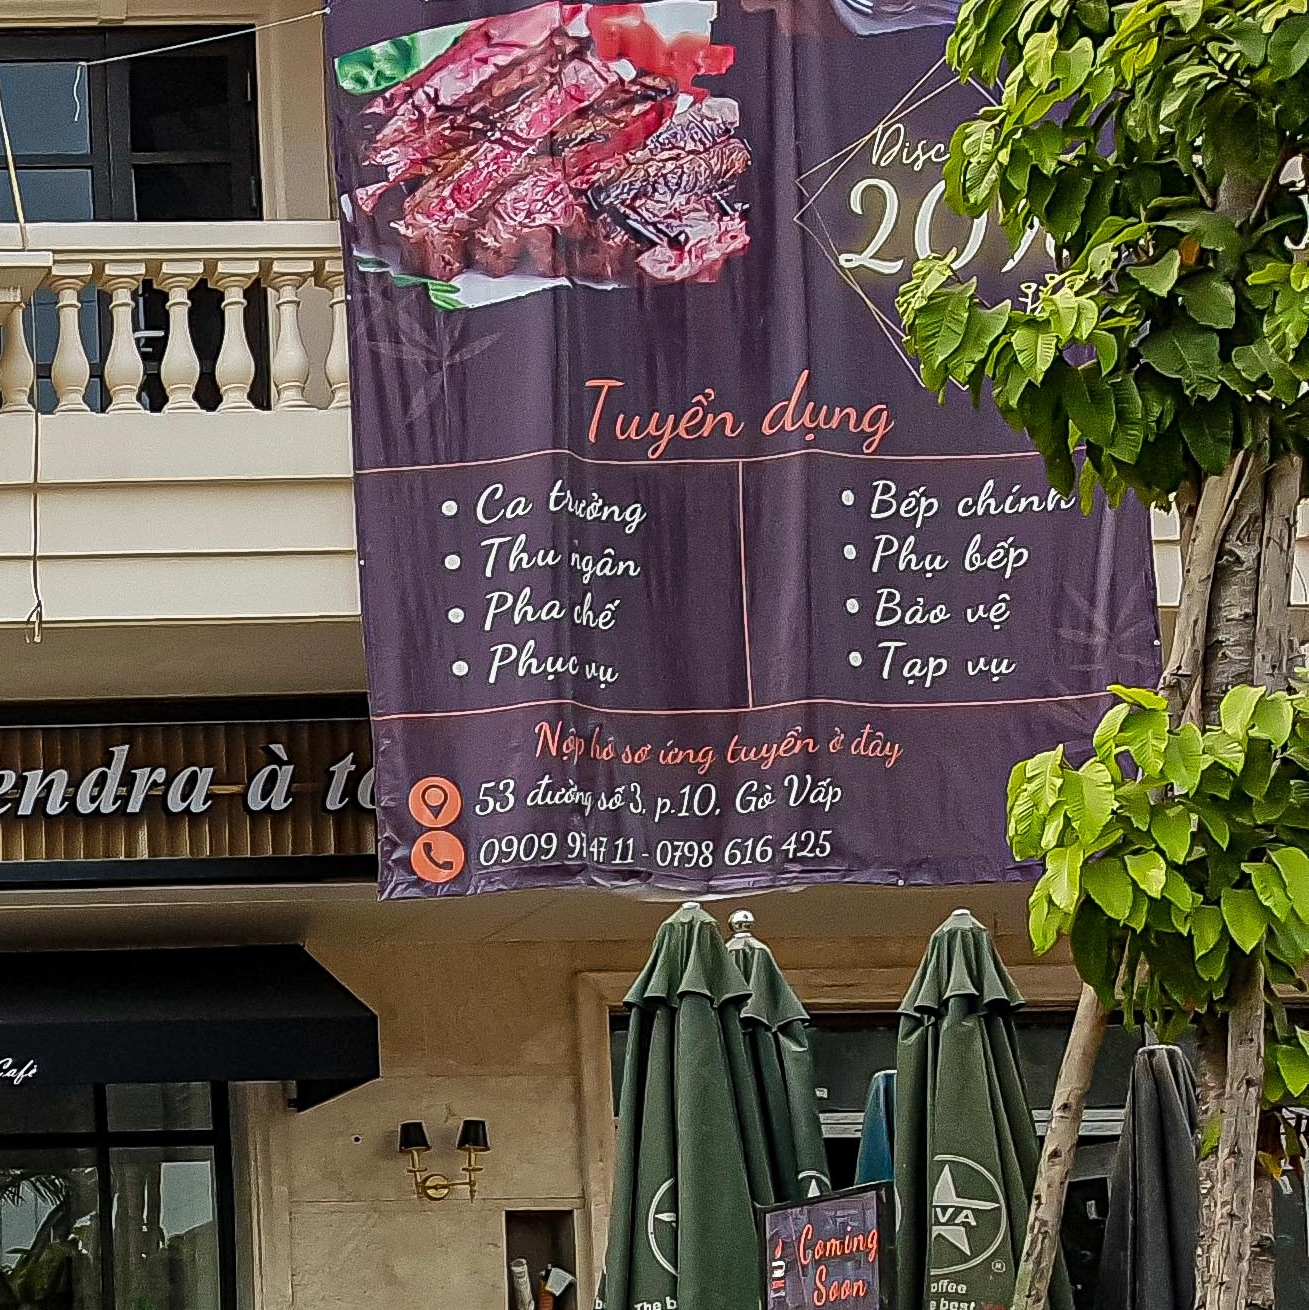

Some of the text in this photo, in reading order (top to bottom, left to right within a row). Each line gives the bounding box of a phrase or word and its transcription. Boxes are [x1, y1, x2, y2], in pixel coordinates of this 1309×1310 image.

[871, 122, 950, 171] Disc
[584, 368, 895, 461] Tuyển dụng
[476, 483, 532, 525] Ca
[870, 479, 1076, 529] Bếp chính
[480, 533, 563, 578] Thu
[871, 533, 1030, 579] Phụ bếp
[484, 586, 621, 631] Pha chế
[875, 588, 1011, 630] Bảo vệ
[487, 639, 619, 689] Phục vụ
[877, 641, 1016, 688] Tạp vụ
[658, 737, 717, 775] ứng
[726, 725, 821, 770] tuyển
[827, 727, 845, 753] ở
[850, 723, 904, 768] đây
[245, 743, 294, 816] à
[474, 779, 516, 816] 53
[735, 780, 777, 811] Gò
[783, 774, 843, 815] Vấp
[479, 832, 557, 867] 0909
[656, 839, 714, 868] 0798
[724, 834, 773, 864] 616
[781, 830, 833, 858] 425
[799, 1224, 880, 1264] Coming
[813, 1264, 867, 1307] Soon
[930, 1279, 967, 1294] offee
